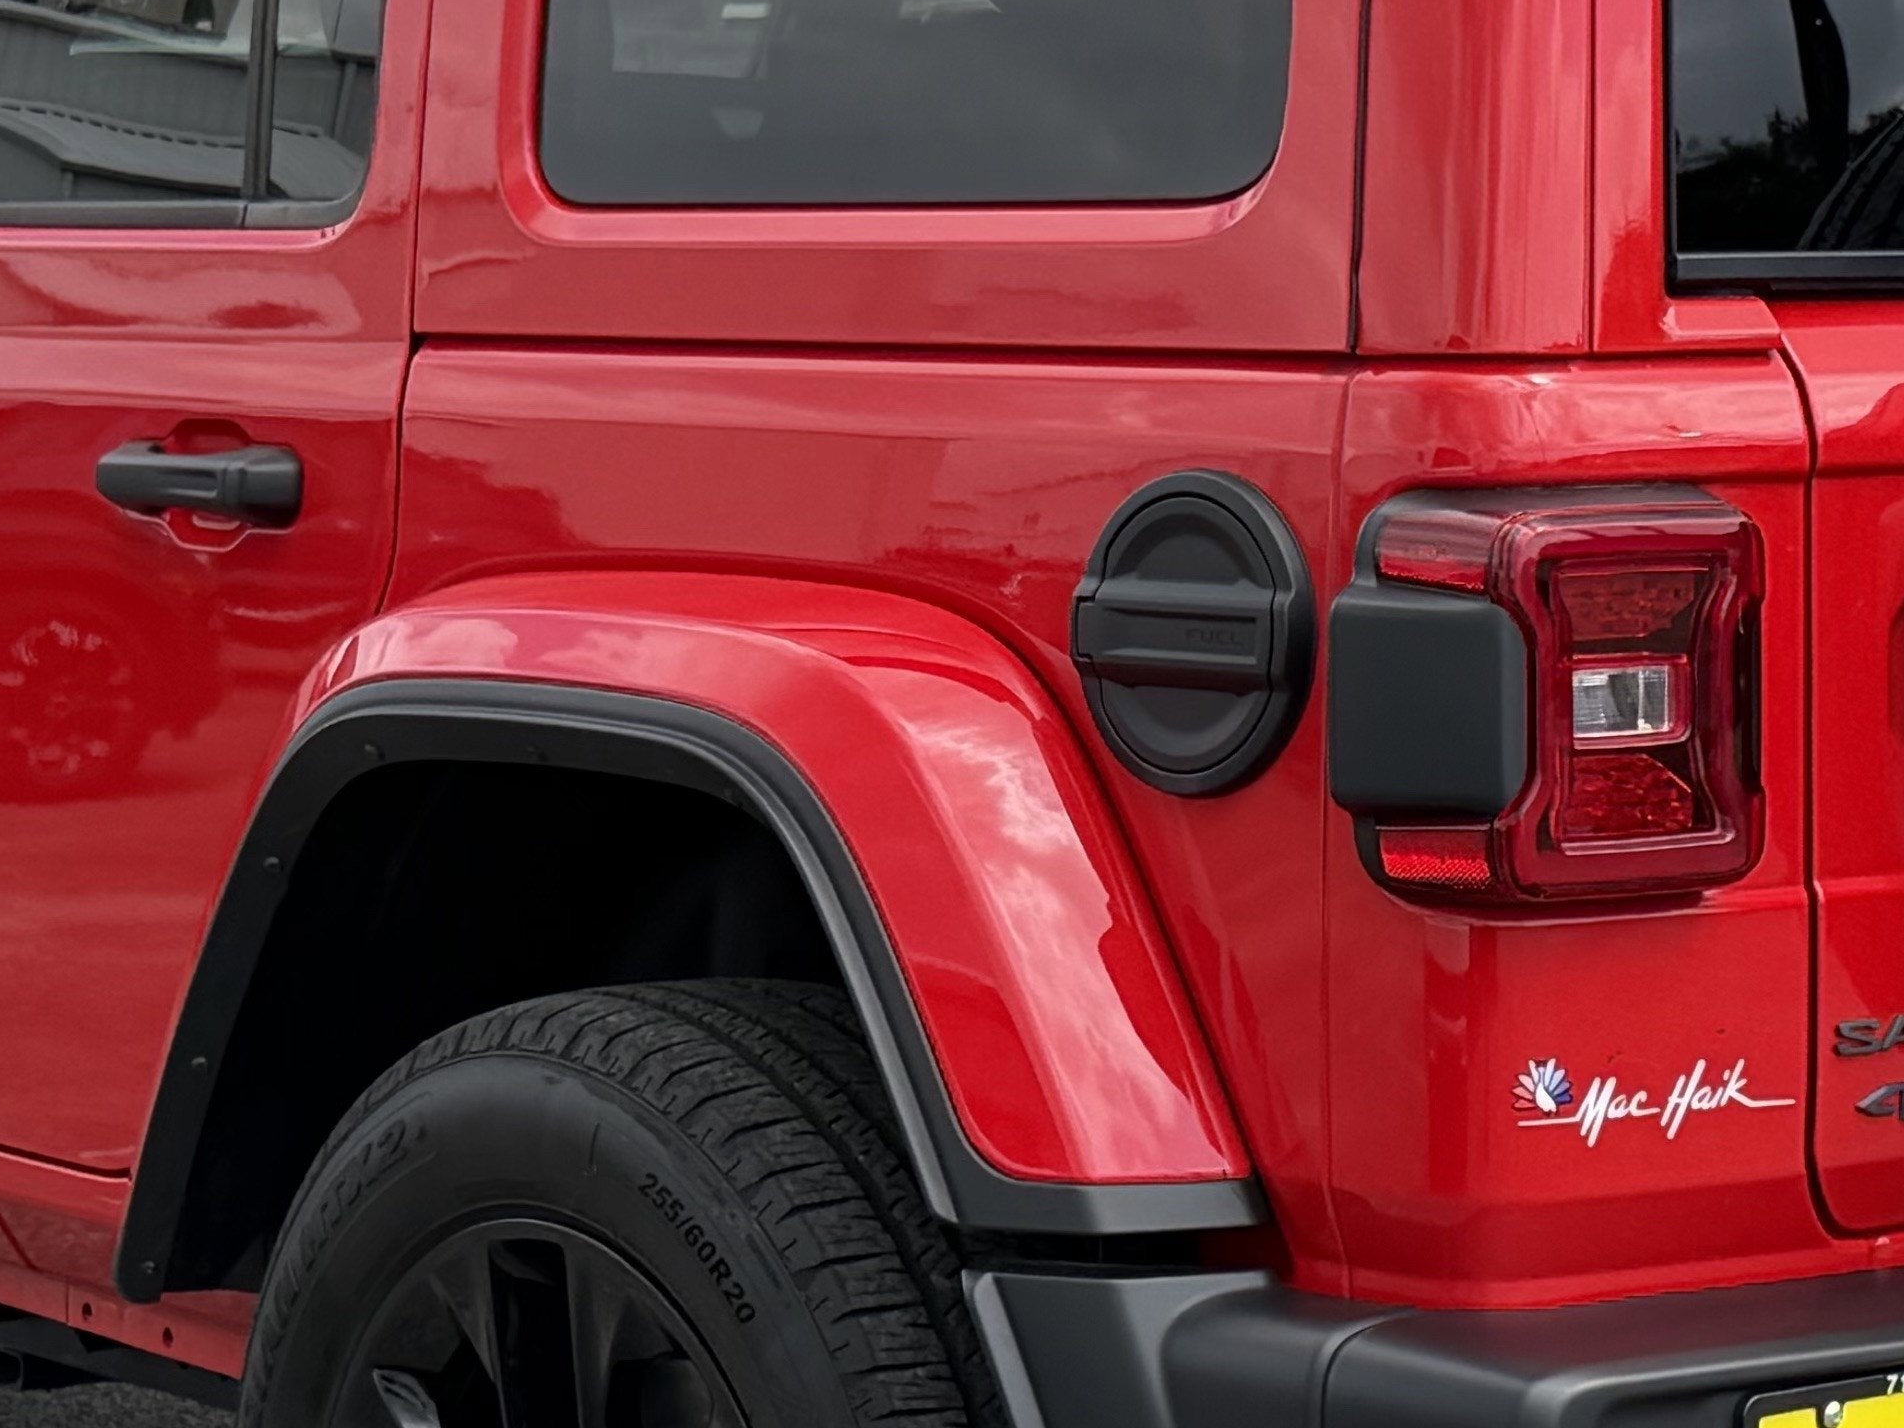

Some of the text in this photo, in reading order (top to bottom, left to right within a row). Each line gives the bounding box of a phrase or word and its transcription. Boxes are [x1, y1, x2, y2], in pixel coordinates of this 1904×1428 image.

[1518, 1058, 1796, 1147] Mac Haik
[637, 1172, 757, 1324] 255/60R20
